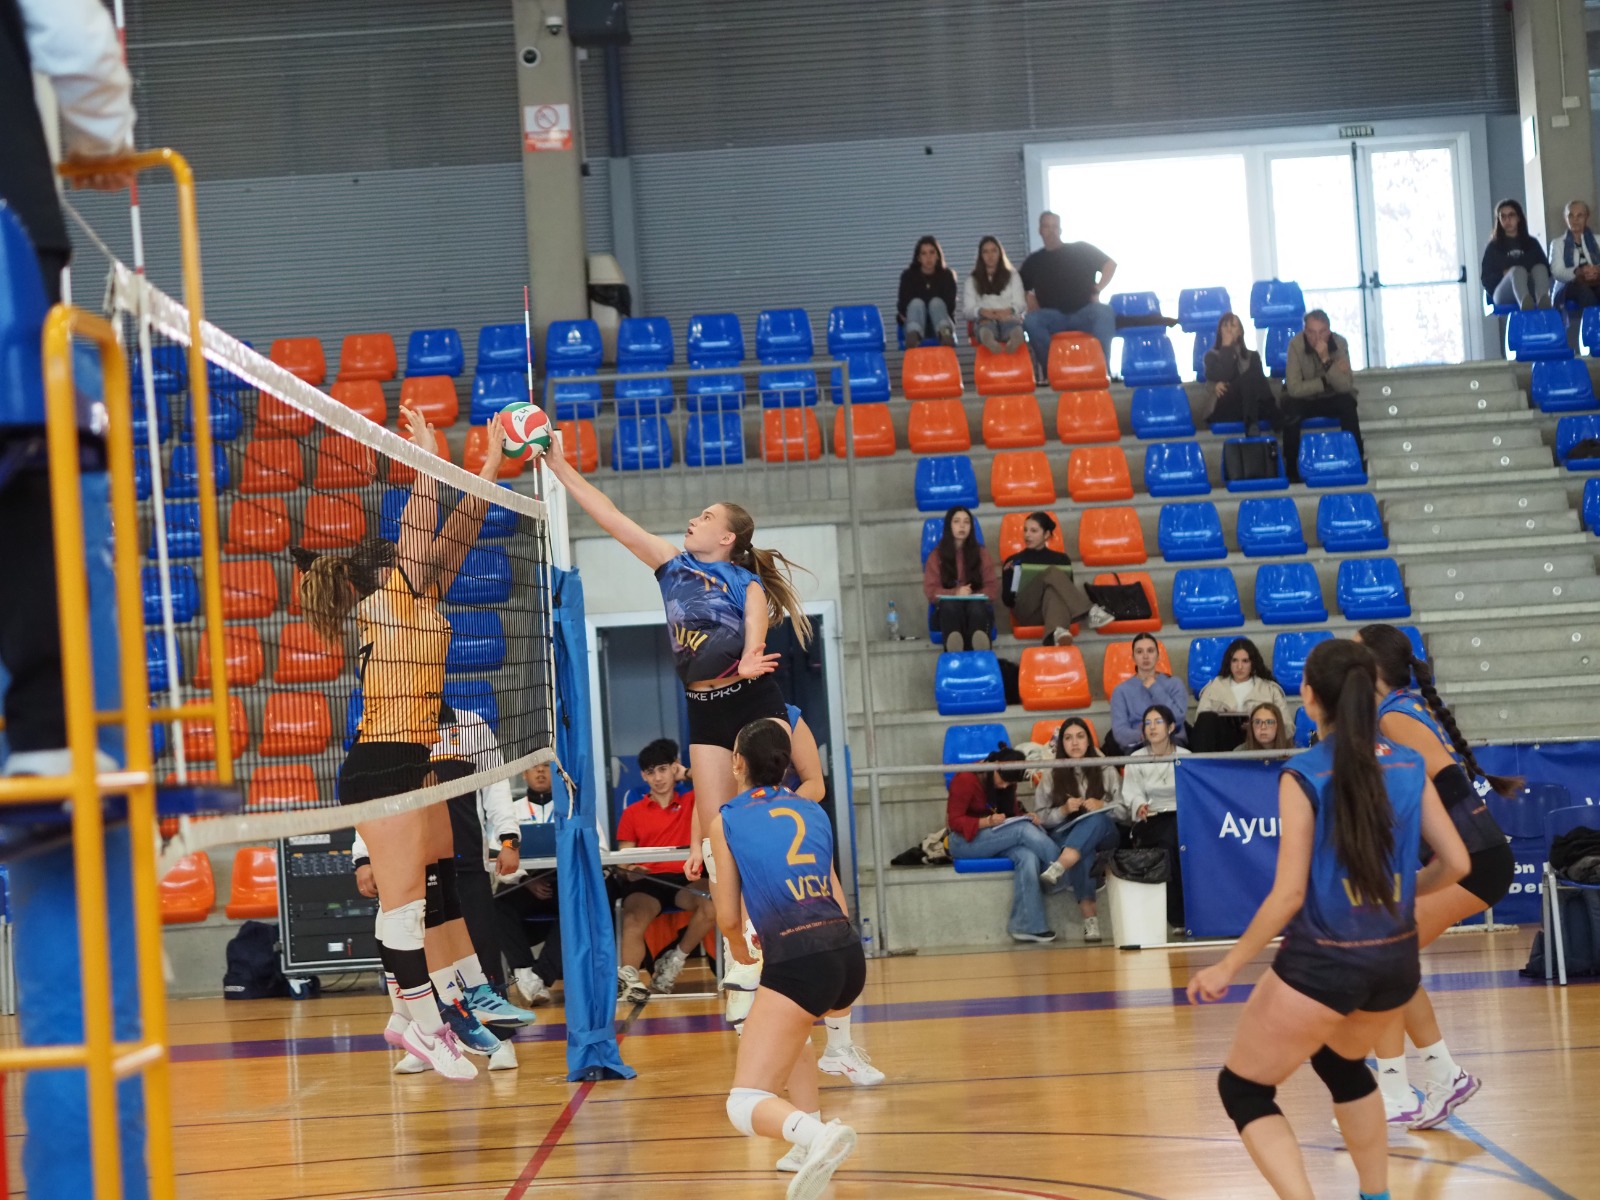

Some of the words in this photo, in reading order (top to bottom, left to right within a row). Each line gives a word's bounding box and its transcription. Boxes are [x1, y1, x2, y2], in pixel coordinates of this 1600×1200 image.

[686, 691, 708, 701] NIKE
[710, 683, 742, 700] PRO
[769, 807, 816, 865] 2
[1218, 811, 1282, 844] Ayu
